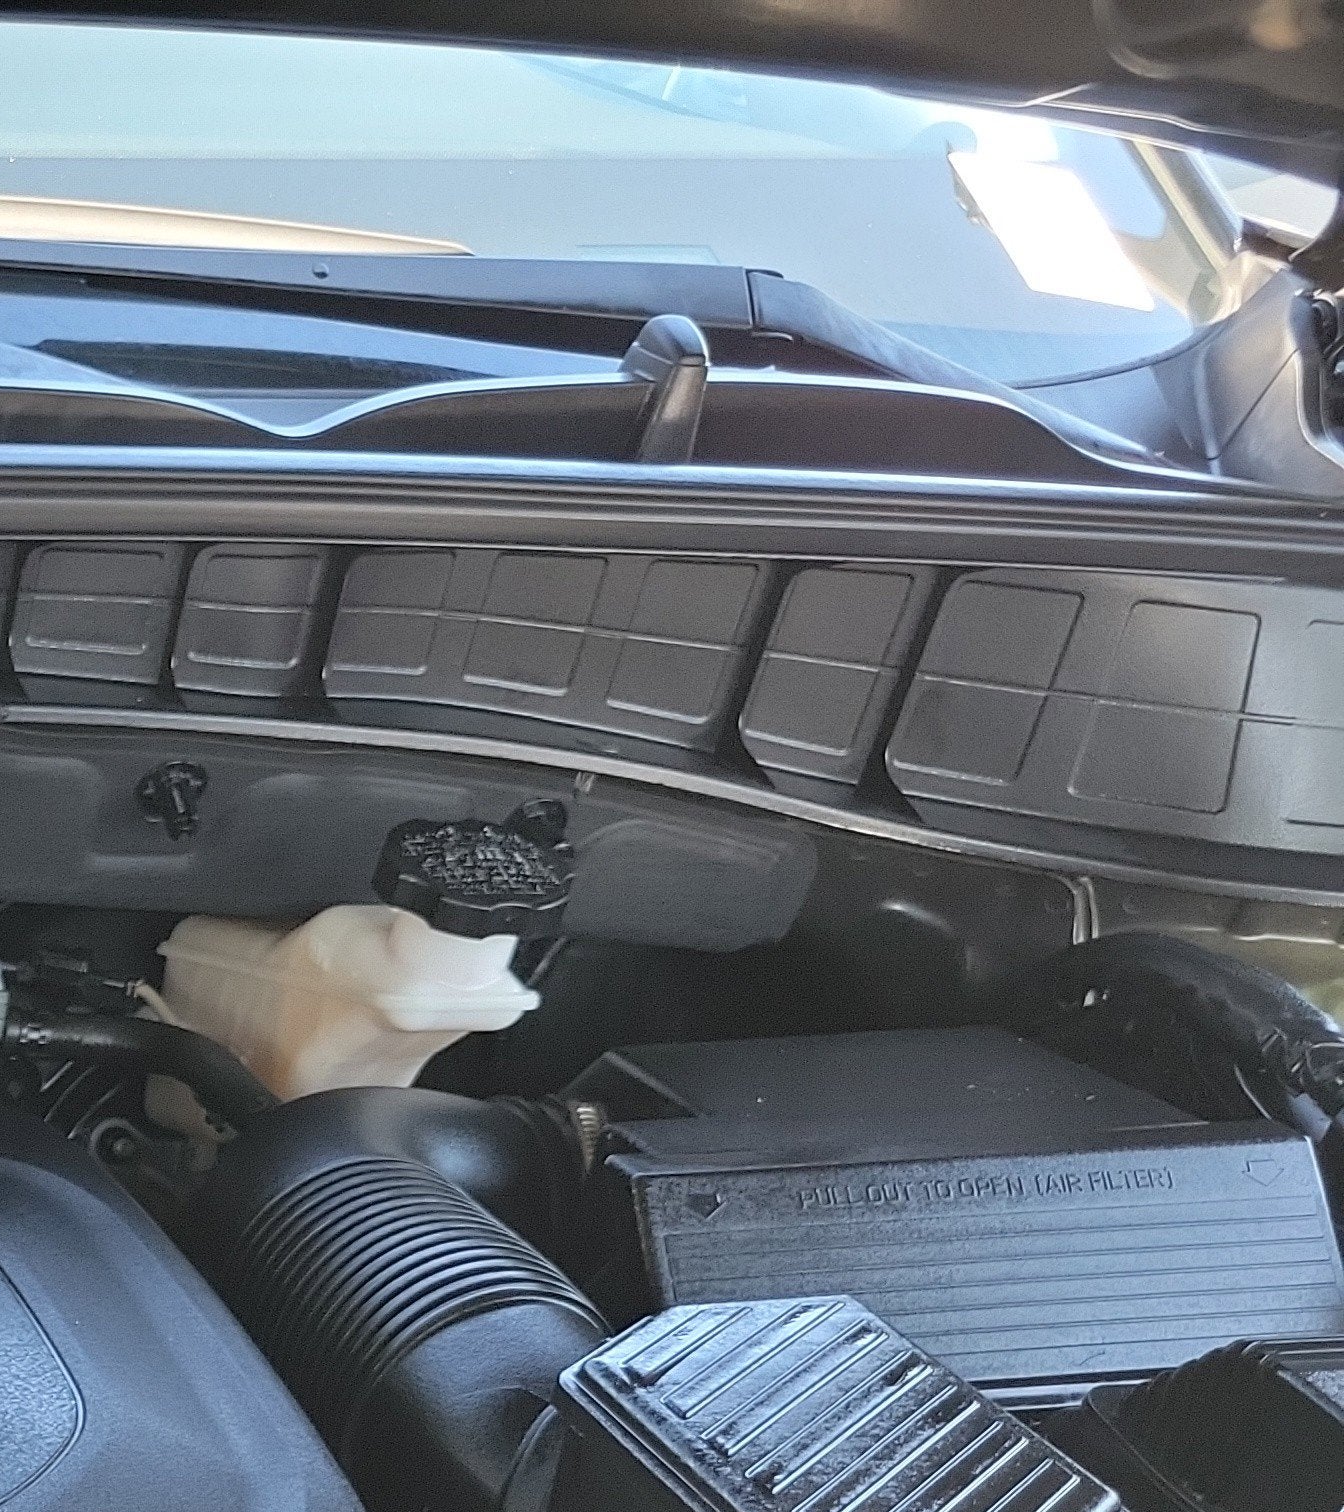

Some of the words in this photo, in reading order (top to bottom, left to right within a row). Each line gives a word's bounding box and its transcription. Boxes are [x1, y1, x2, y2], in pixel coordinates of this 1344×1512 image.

[798, 1186, 864, 1209] PULL
[865, 1182, 914, 1205] OUT
[919, 1179, 954, 1201] TO
[958, 1176, 1025, 1198] OPEN
[1034, 1172, 1083, 1196] (AIR
[1087, 1167, 1174, 1192] FILTER)
